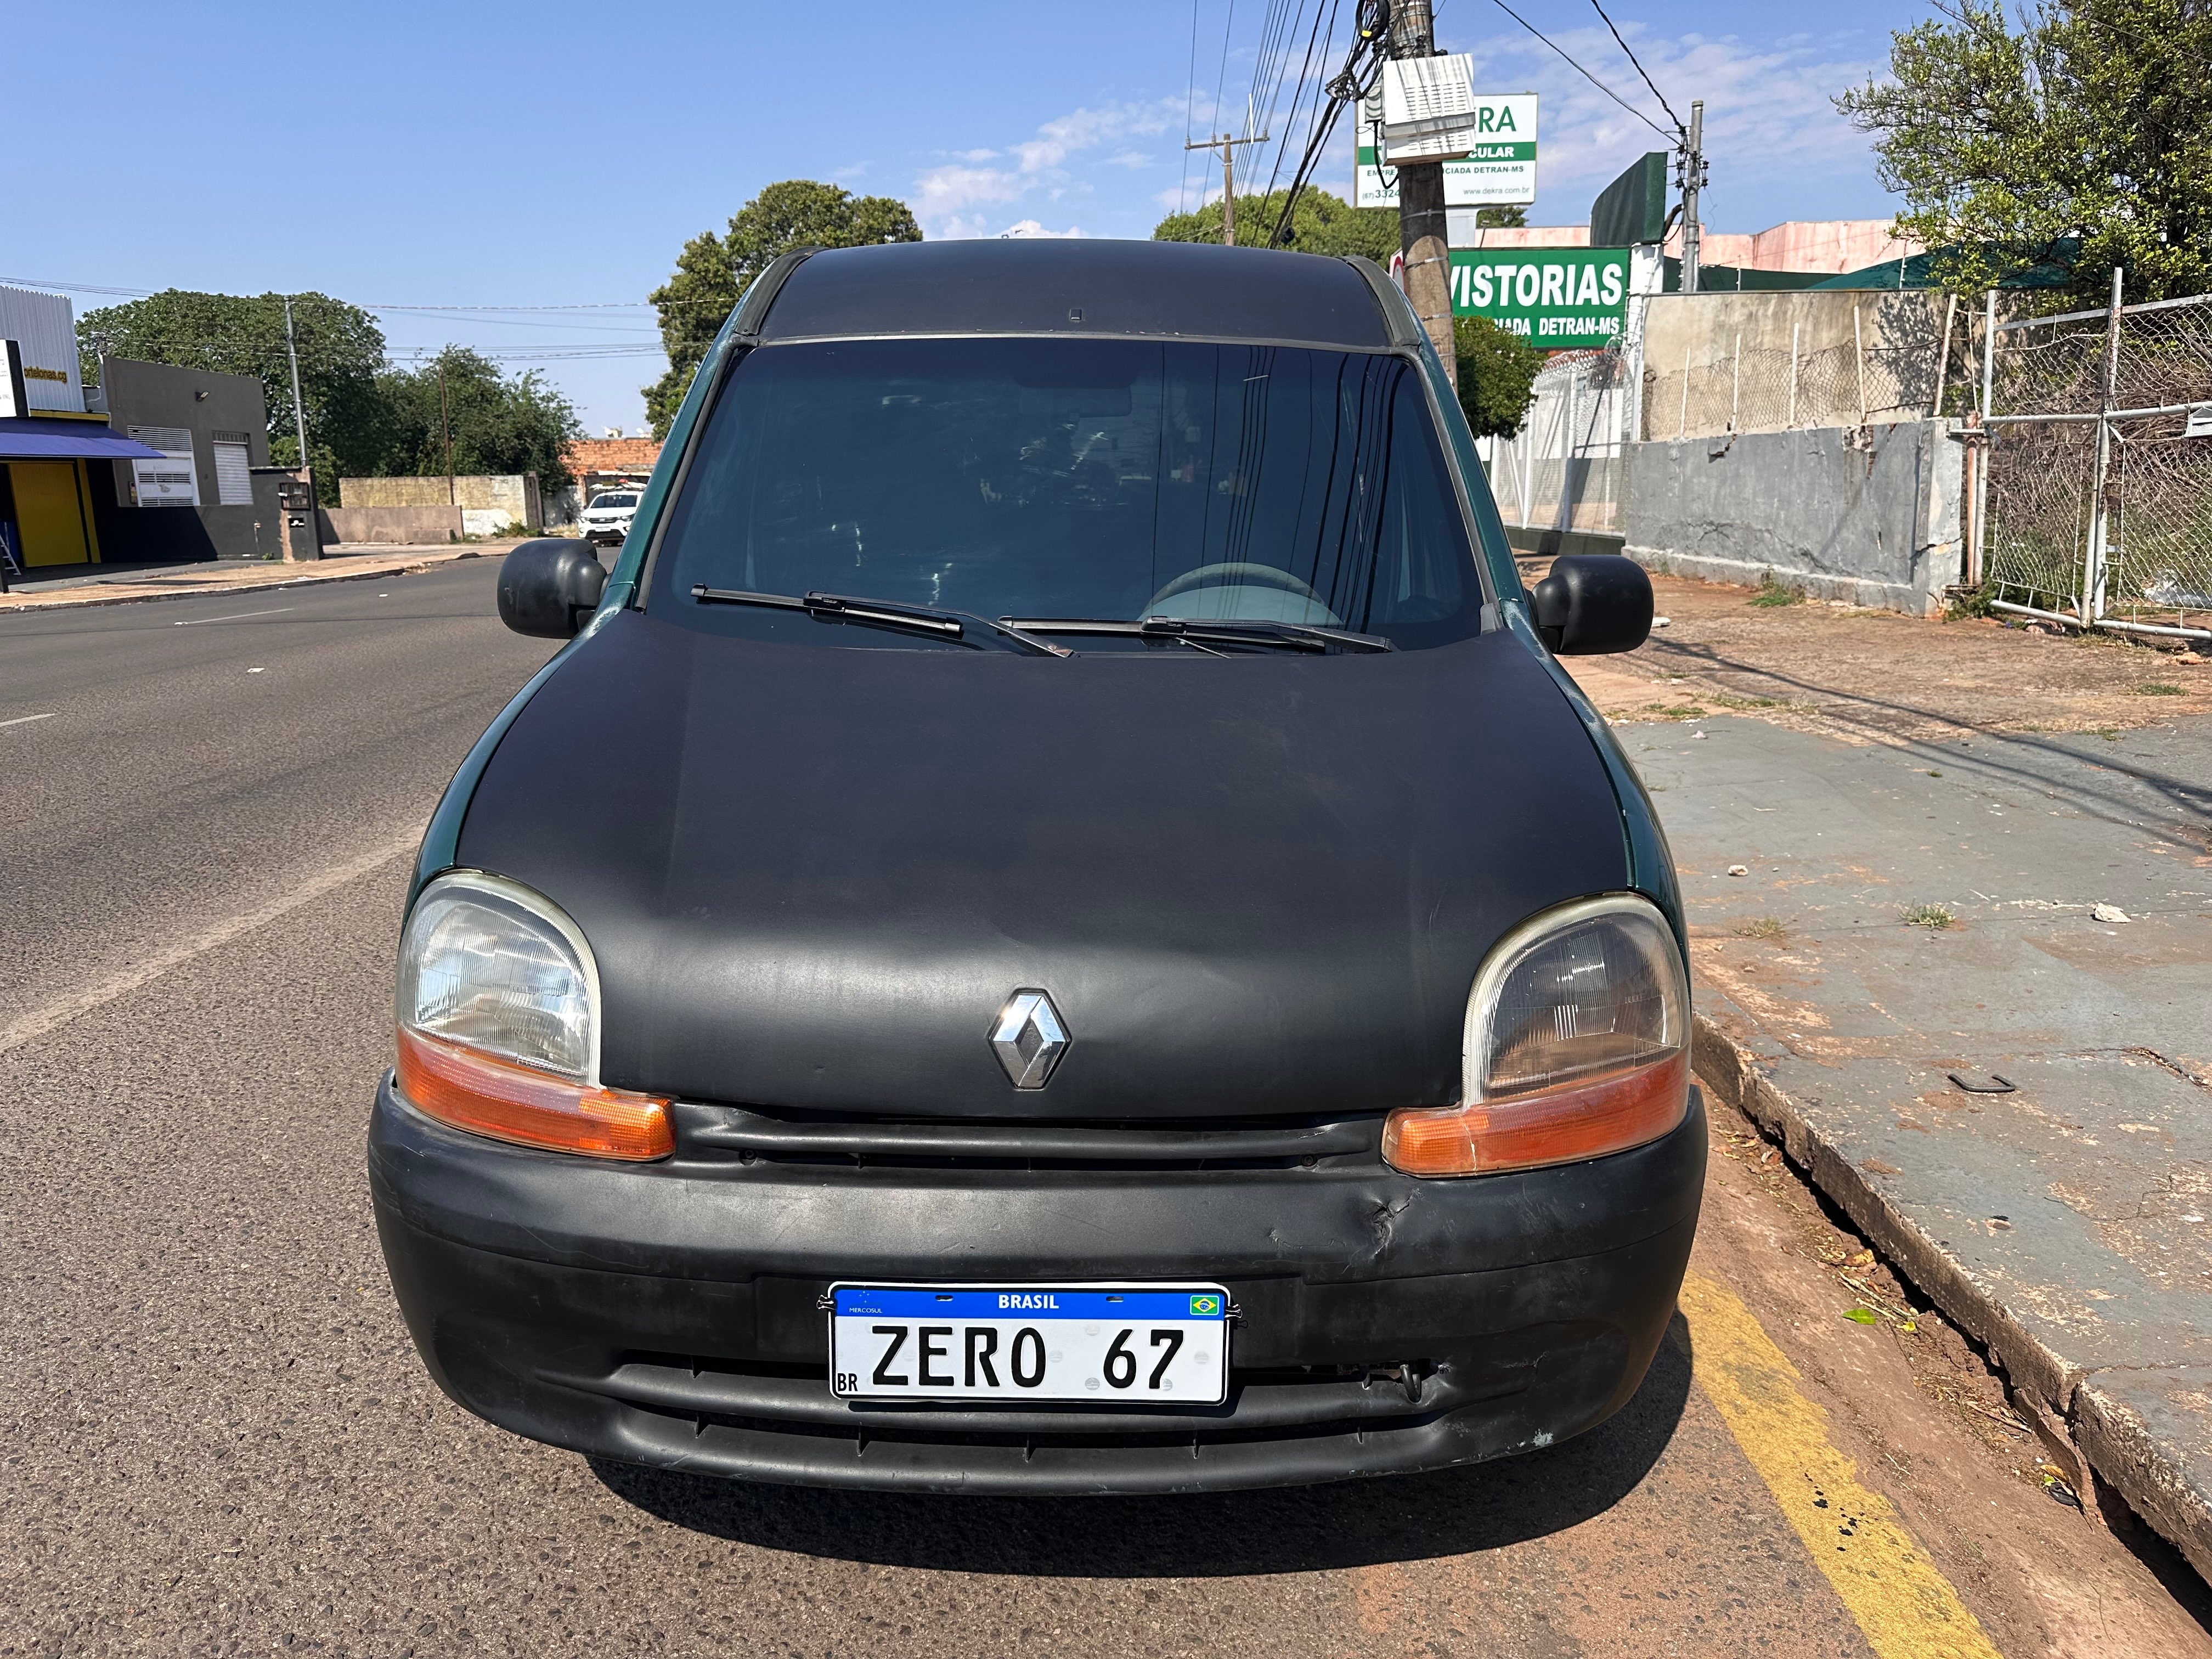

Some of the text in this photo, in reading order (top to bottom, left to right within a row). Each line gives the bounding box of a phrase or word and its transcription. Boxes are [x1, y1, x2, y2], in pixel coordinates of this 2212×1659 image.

[1475, 105, 1517, 133] RA
[1450, 263, 1623, 307] VISTORIAS
[1538, 317, 1620, 335] DETRAN-MS
[998, 1294, 1059, 1309] BRASIL
[872, 1325, 1184, 1389] ZERO 67
[837, 1373, 858, 1392] BR
